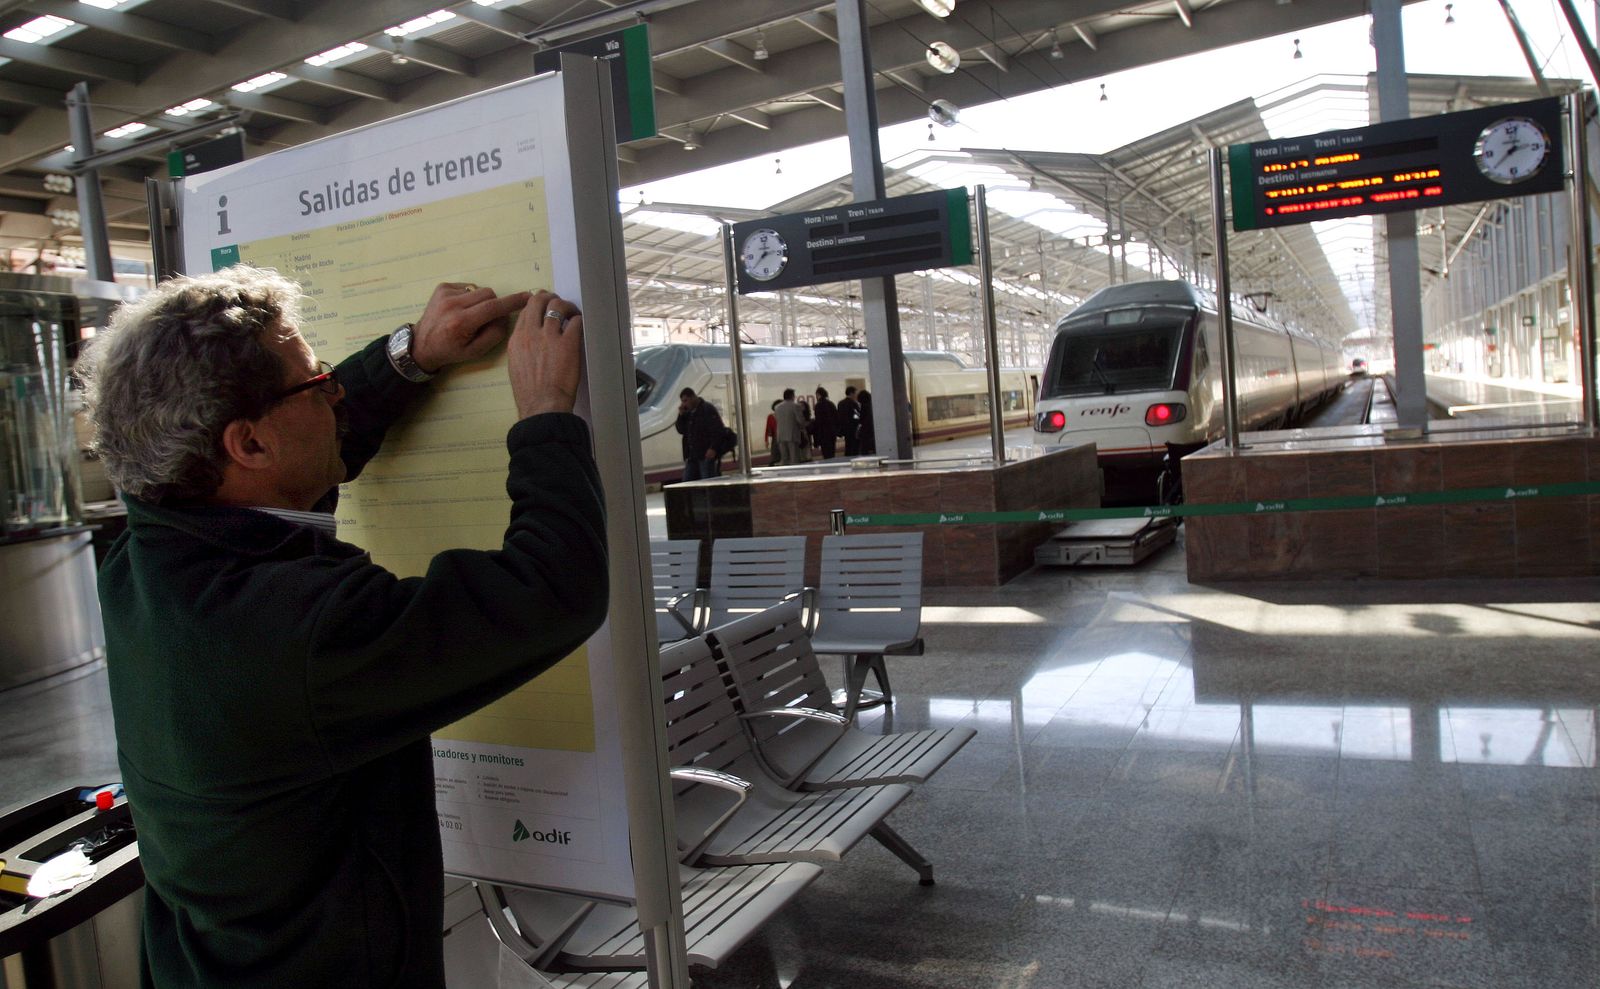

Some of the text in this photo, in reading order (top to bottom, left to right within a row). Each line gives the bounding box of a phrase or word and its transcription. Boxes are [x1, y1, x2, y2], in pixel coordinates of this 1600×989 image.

[1314, 136, 1363, 148] Tren TRAIN
[1255, 147, 1278, 157] Hora
[298, 147, 503, 216] Salidas de trenes
[1258, 169, 1338, 185] Destino DESTINATION
[528, 201, 534, 212] 4
[848, 209, 865, 217] Tren
[804, 216, 822, 225] Hora
[531, 232, 537, 243] 1
[806, 238, 834, 248] Destino
[1081, 403, 1131, 419] renfe
[433, 747, 525, 767] icadores y monitores
[532, 828, 572, 845] adif
